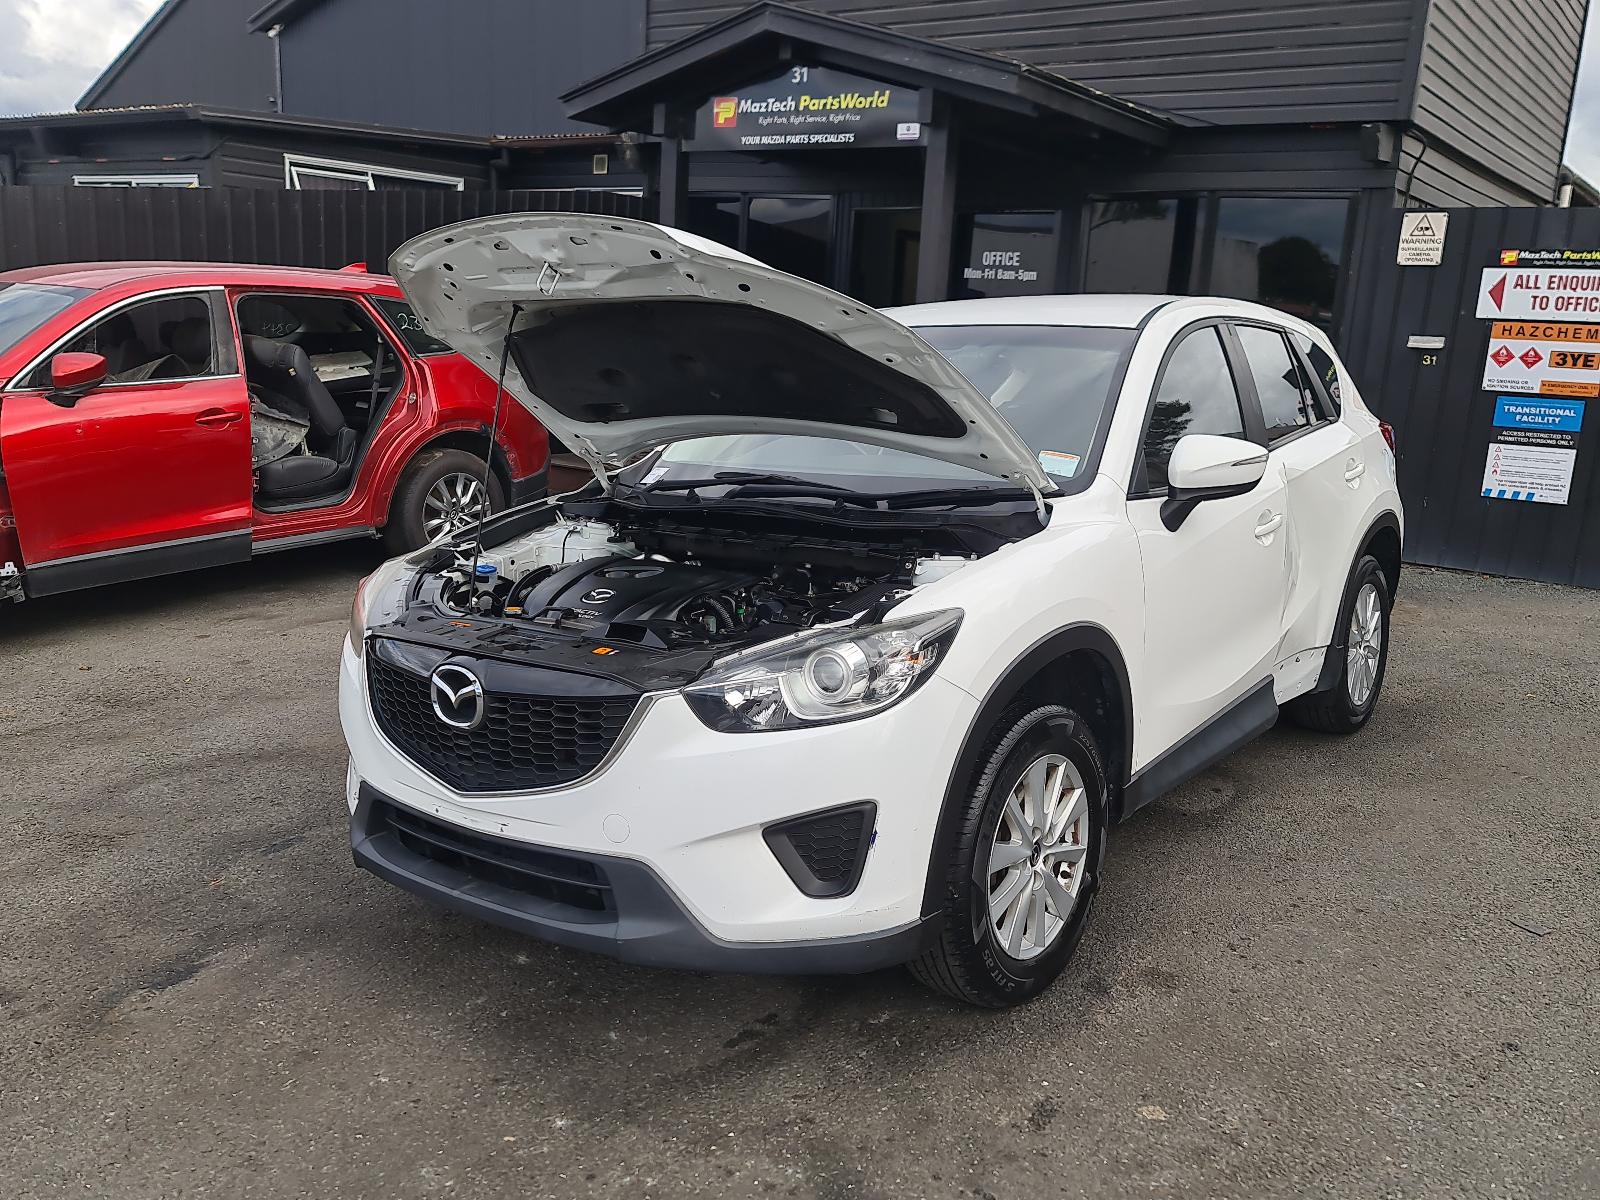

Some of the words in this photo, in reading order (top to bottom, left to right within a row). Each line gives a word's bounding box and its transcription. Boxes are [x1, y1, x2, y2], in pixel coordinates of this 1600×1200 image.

[791, 67, 809, 83] 31
[738, 96, 796, 113] MazTech
[798, 90, 890, 111] PartsWorld
[758, 116, 773, 126] Right
[790, 115, 805, 125] Right
[829, 113, 846, 124] Right
[740, 135, 760, 145] YOUR
[761, 135, 785, 144] MAZDA
[785, 134, 809, 144] PARTS
[809, 133, 855, 143] SPECIALISTS
[982, 251, 1021, 266] OFFICE
[1518, 251, 1562, 259] MazTech
[963, 268, 996, 279] Mon-Fri
[997, 269, 1038, 281] 8am-5pm
[1513, 274, 1541, 290] ALL
[1531, 295, 1550, 311] TO
[1554, 296, 1600, 312] OFFIC
[1501, 325, 1599, 340] HAZCHEM
[1422, 355, 1437, 365] 31
[1555, 352, 1596, 368] 3YE
[1503, 405, 1577, 416] TRANSITIONAL
[1515, 415, 1561, 424] FACILITY
[1525, 431, 1562, 439] RESTRICTED
